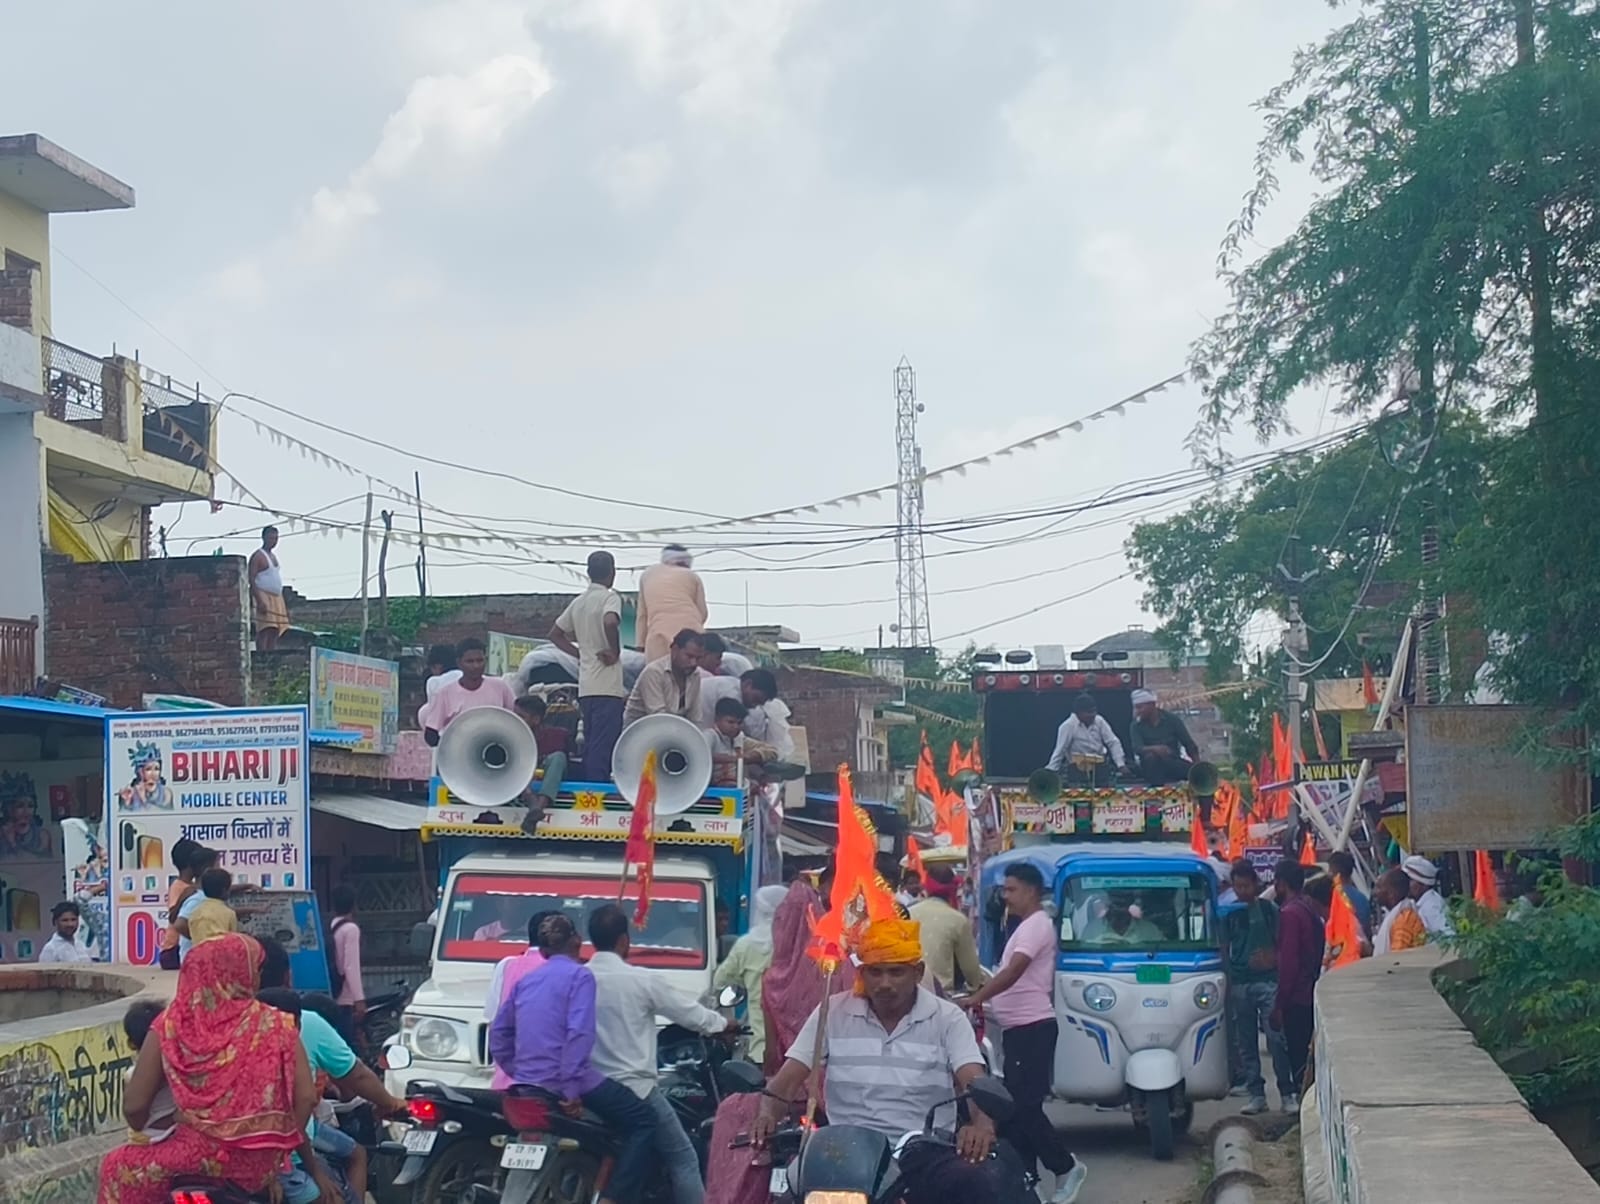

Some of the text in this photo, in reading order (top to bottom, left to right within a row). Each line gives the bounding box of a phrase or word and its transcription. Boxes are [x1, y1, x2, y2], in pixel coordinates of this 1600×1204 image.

[172, 748, 298, 785] BIHARI JI
[181, 790, 288, 809] MOBILE CENTER
[180, 816, 293, 841] आसान किस्तों में
[438, 810, 465, 823] शुभ
[580, 812, 602, 827] श्री
[703, 820, 730, 832] लाभ
[229, 848, 279, 866] उपलब्ध
[95, 1035, 134, 1124] ओ
